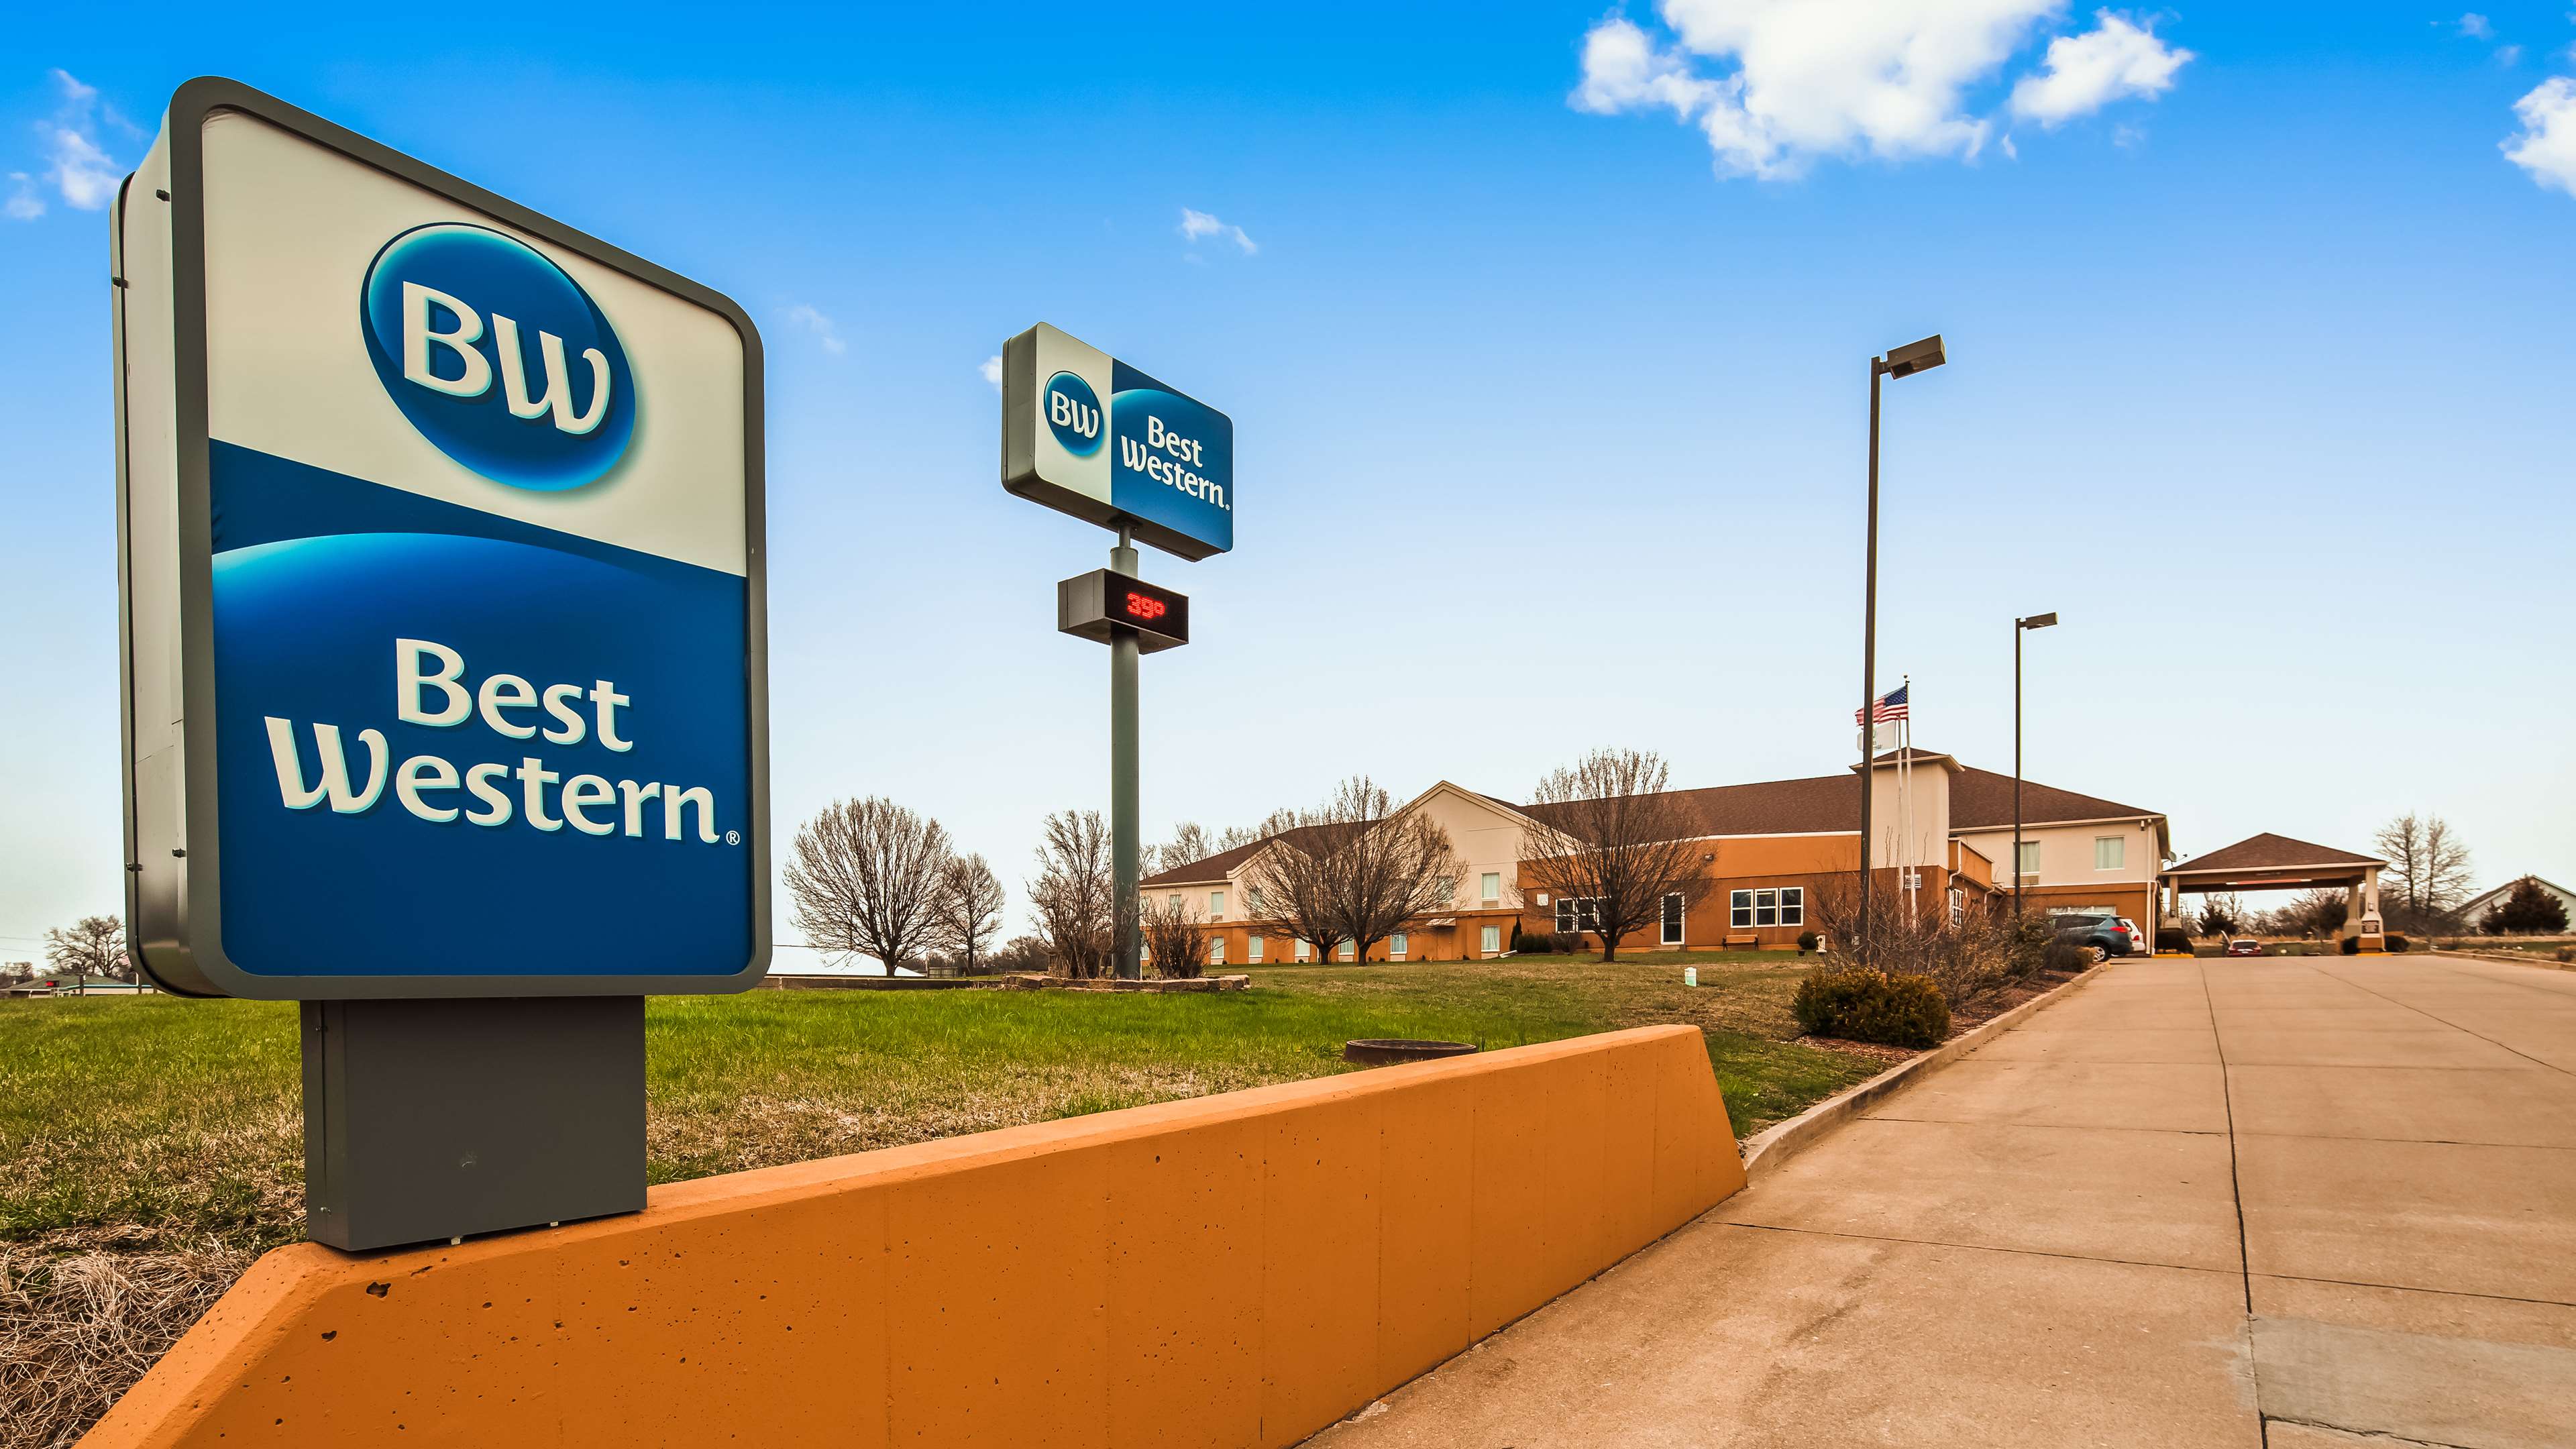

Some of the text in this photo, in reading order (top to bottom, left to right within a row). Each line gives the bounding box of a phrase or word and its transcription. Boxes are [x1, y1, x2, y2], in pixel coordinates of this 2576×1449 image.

[402, 280, 611, 435] BW
[1051, 390, 1099, 439] BW
[1148, 415, 1203, 468] Best
[395, 637, 634, 753] Best
